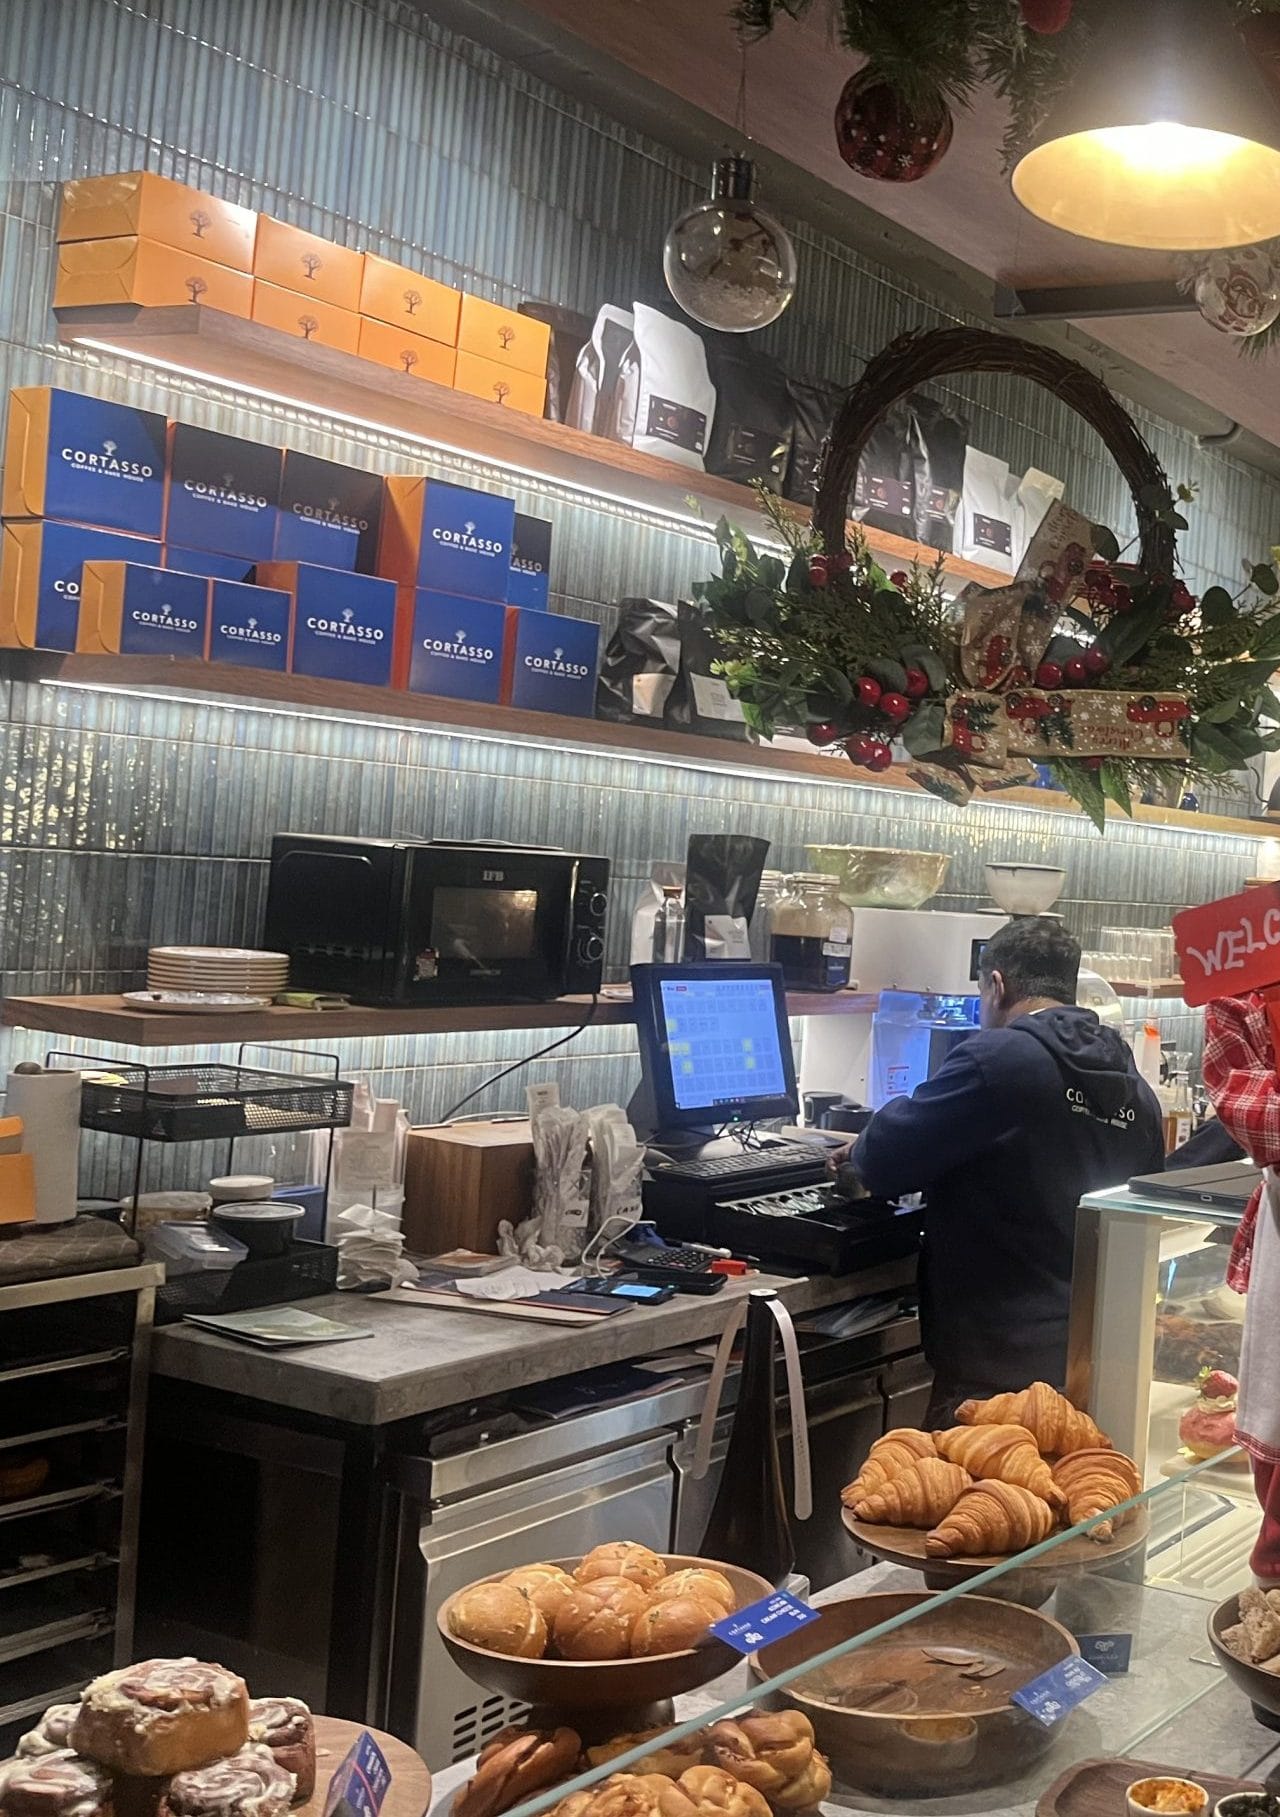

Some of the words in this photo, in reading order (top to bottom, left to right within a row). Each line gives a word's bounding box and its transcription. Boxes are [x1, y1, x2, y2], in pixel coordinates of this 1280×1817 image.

[62, 448, 153, 477] CORTASSO
[184, 480, 267, 508] CORTASSO
[293, 503, 368, 531] CORTASSO
[432, 528, 502, 553] CORTASSO
[512, 557, 543, 572] ASSO
[132, 610, 197, 630] CORTASSO
[307, 617, 384, 640] CORTASSO
[220, 624, 281, 642] CORTASSO
[423, 638, 493, 660] CORTASSO
[524, 655, 588, 676] CORTASSO
[1066, 1088, 1135, 1121] COSO
